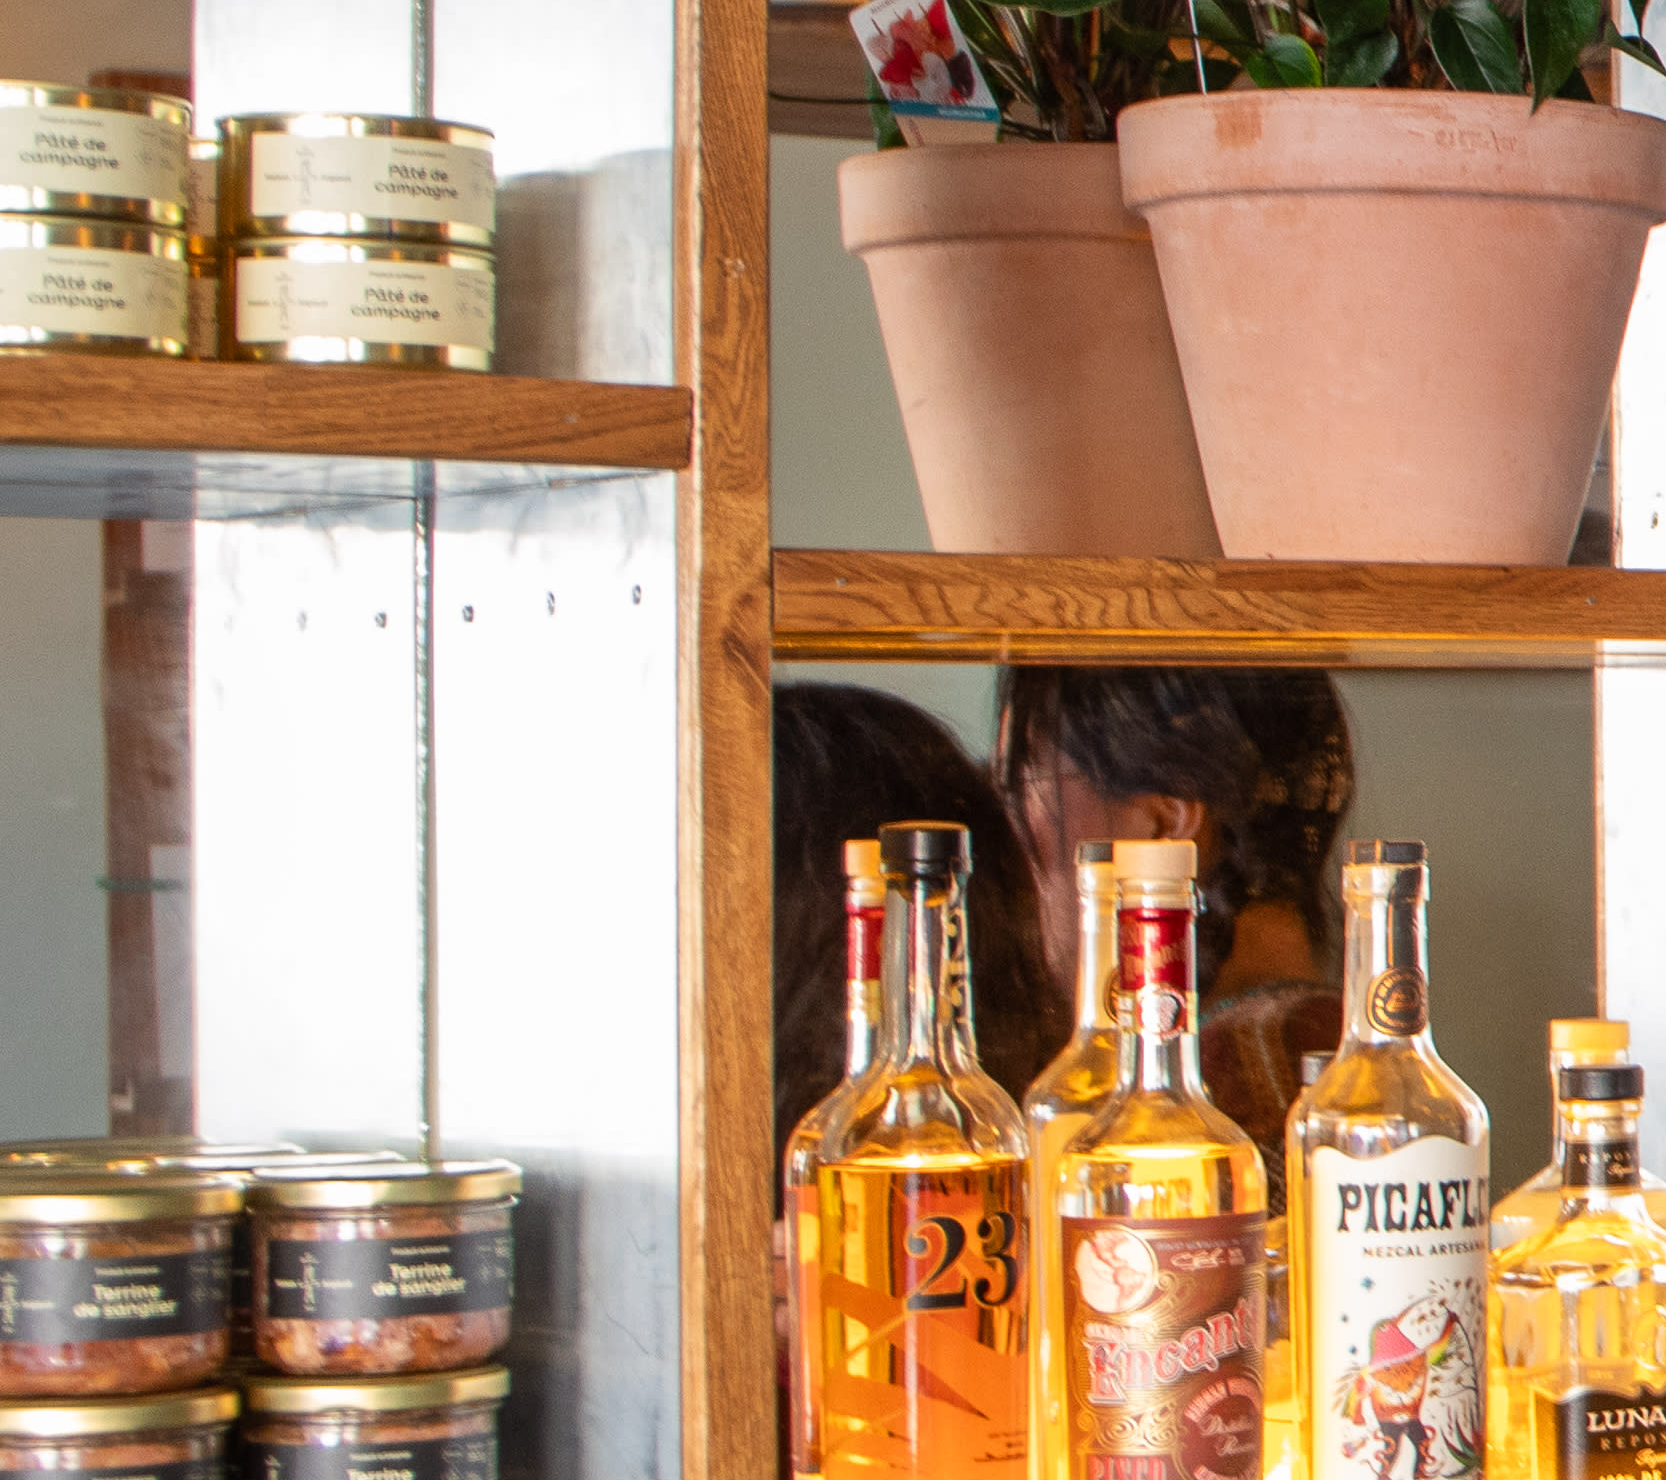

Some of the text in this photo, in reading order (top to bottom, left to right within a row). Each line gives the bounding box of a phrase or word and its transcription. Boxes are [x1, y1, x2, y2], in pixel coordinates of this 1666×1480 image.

[33, 130, 107, 152] Pâté de
[18, 151, 120, 169] campagne
[388, 162, 450, 182] Pâté de
[374, 182, 459, 201] campagne
[42, 272, 113, 293] Pâté de
[26, 292, 125, 310] campagne
[364, 286, 429, 305] Pâté de
[350, 305, 441, 322] campagne
[903, 1210, 1018, 1311] 23
[1363, 1246, 1425, 1258] MEZCAL
[390, 1262, 452, 1281] Terrine
[93, 1283, 162, 1301] Terrine
